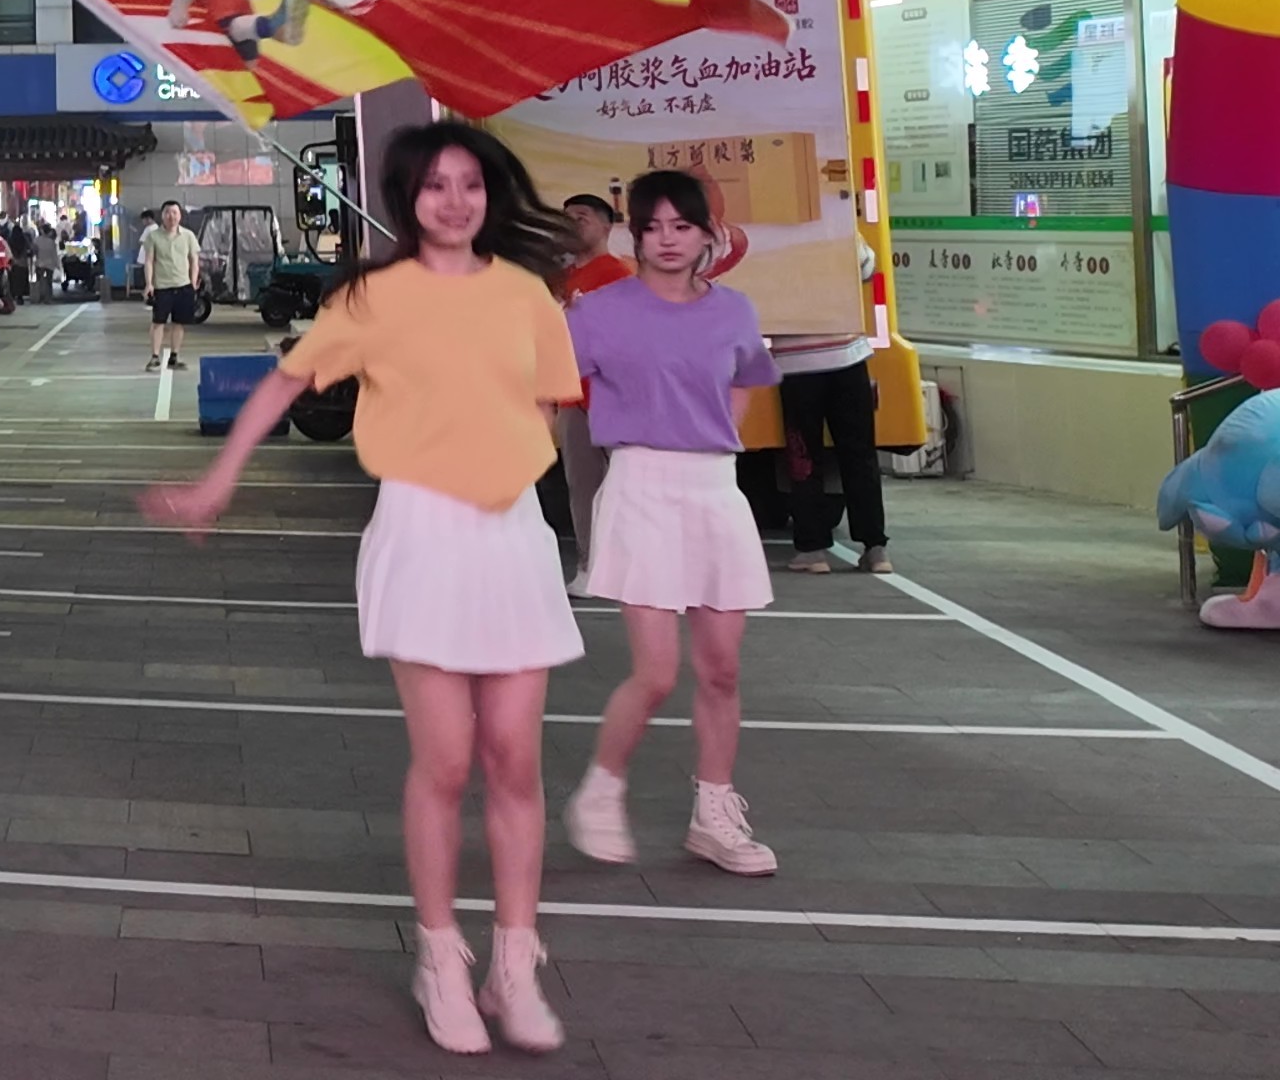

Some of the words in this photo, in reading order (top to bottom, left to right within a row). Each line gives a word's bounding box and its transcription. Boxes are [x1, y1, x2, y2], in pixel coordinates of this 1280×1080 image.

[535, 46, 817, 101] 阿胶浆气血加油站
[596, 97, 654, 119] 好气血
[663, 92, 718, 116] 不再虚
[646, 137, 756, 170] 复方阿胶浆
[1009, 170, 1115, 190] SINOPHARM
